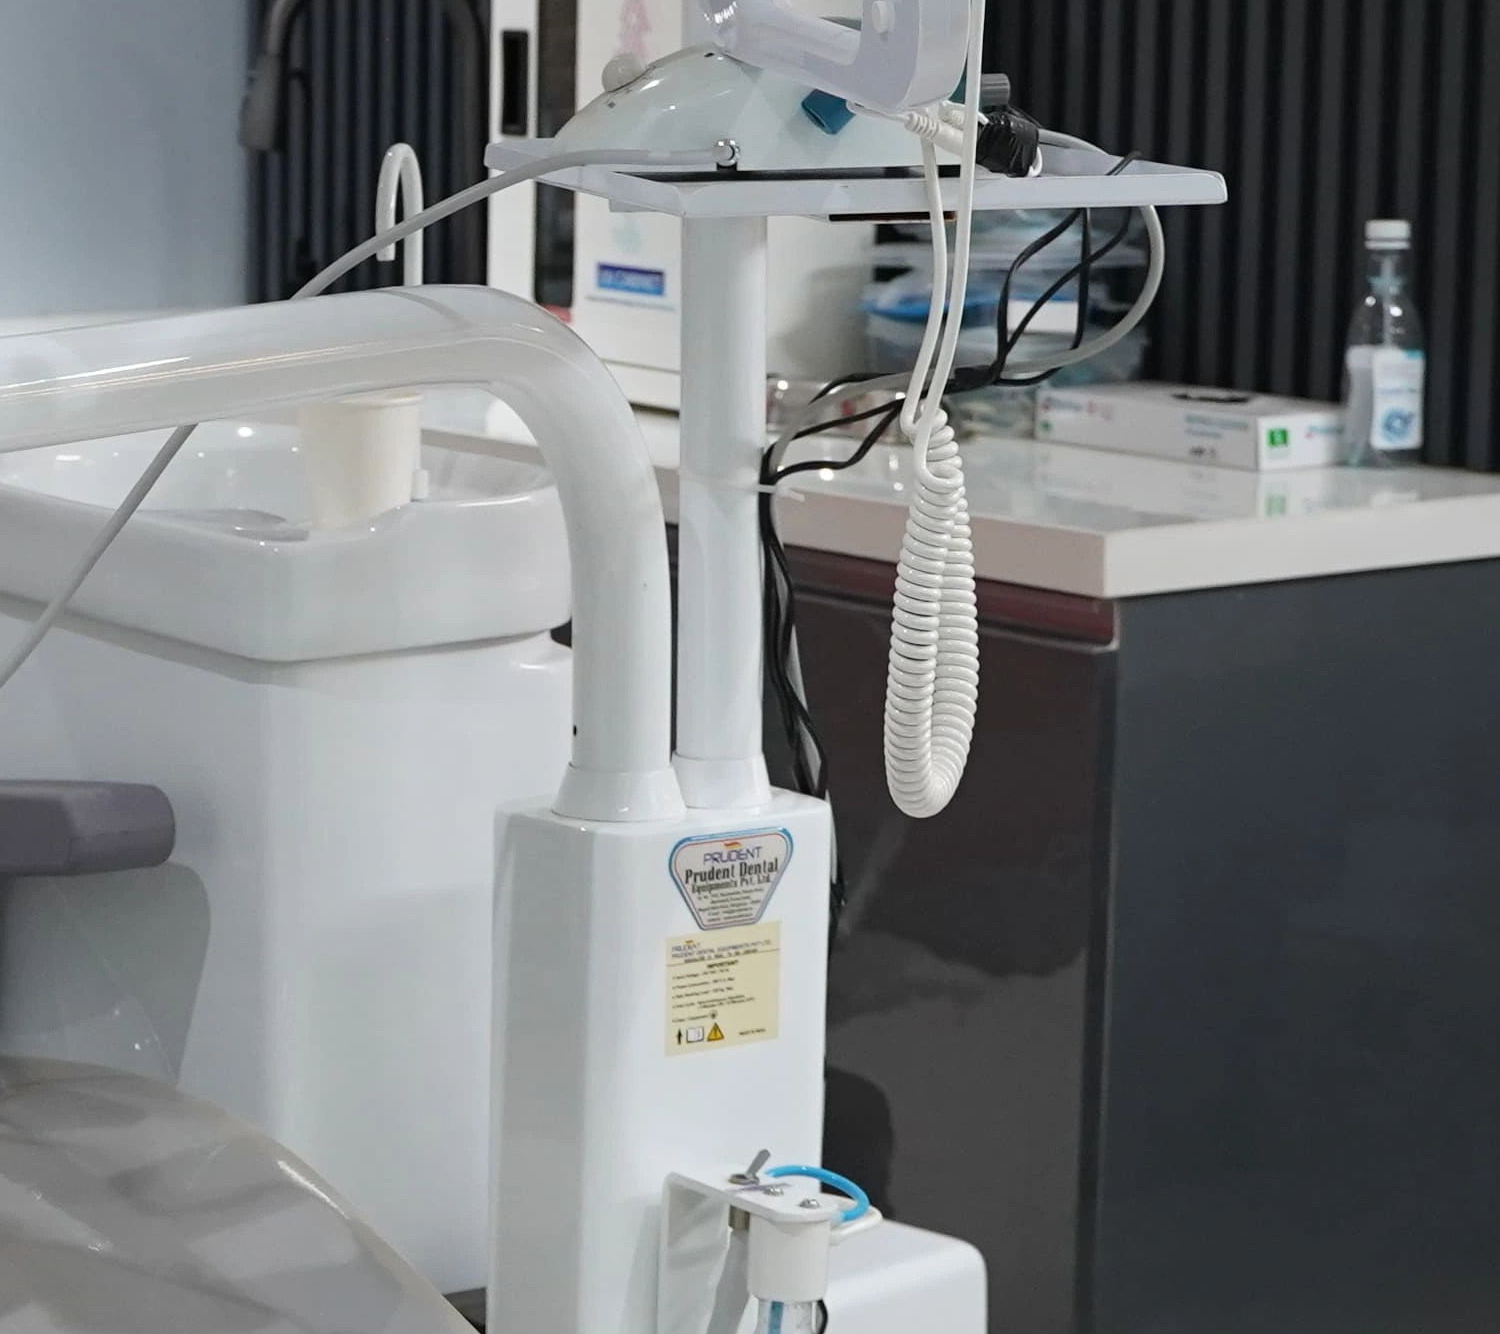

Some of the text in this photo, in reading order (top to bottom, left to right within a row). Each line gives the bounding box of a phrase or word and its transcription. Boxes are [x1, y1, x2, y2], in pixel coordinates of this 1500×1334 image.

[703, 846, 762, 865] PRUDENT
[685, 857, 779, 884] Prudent Dental
